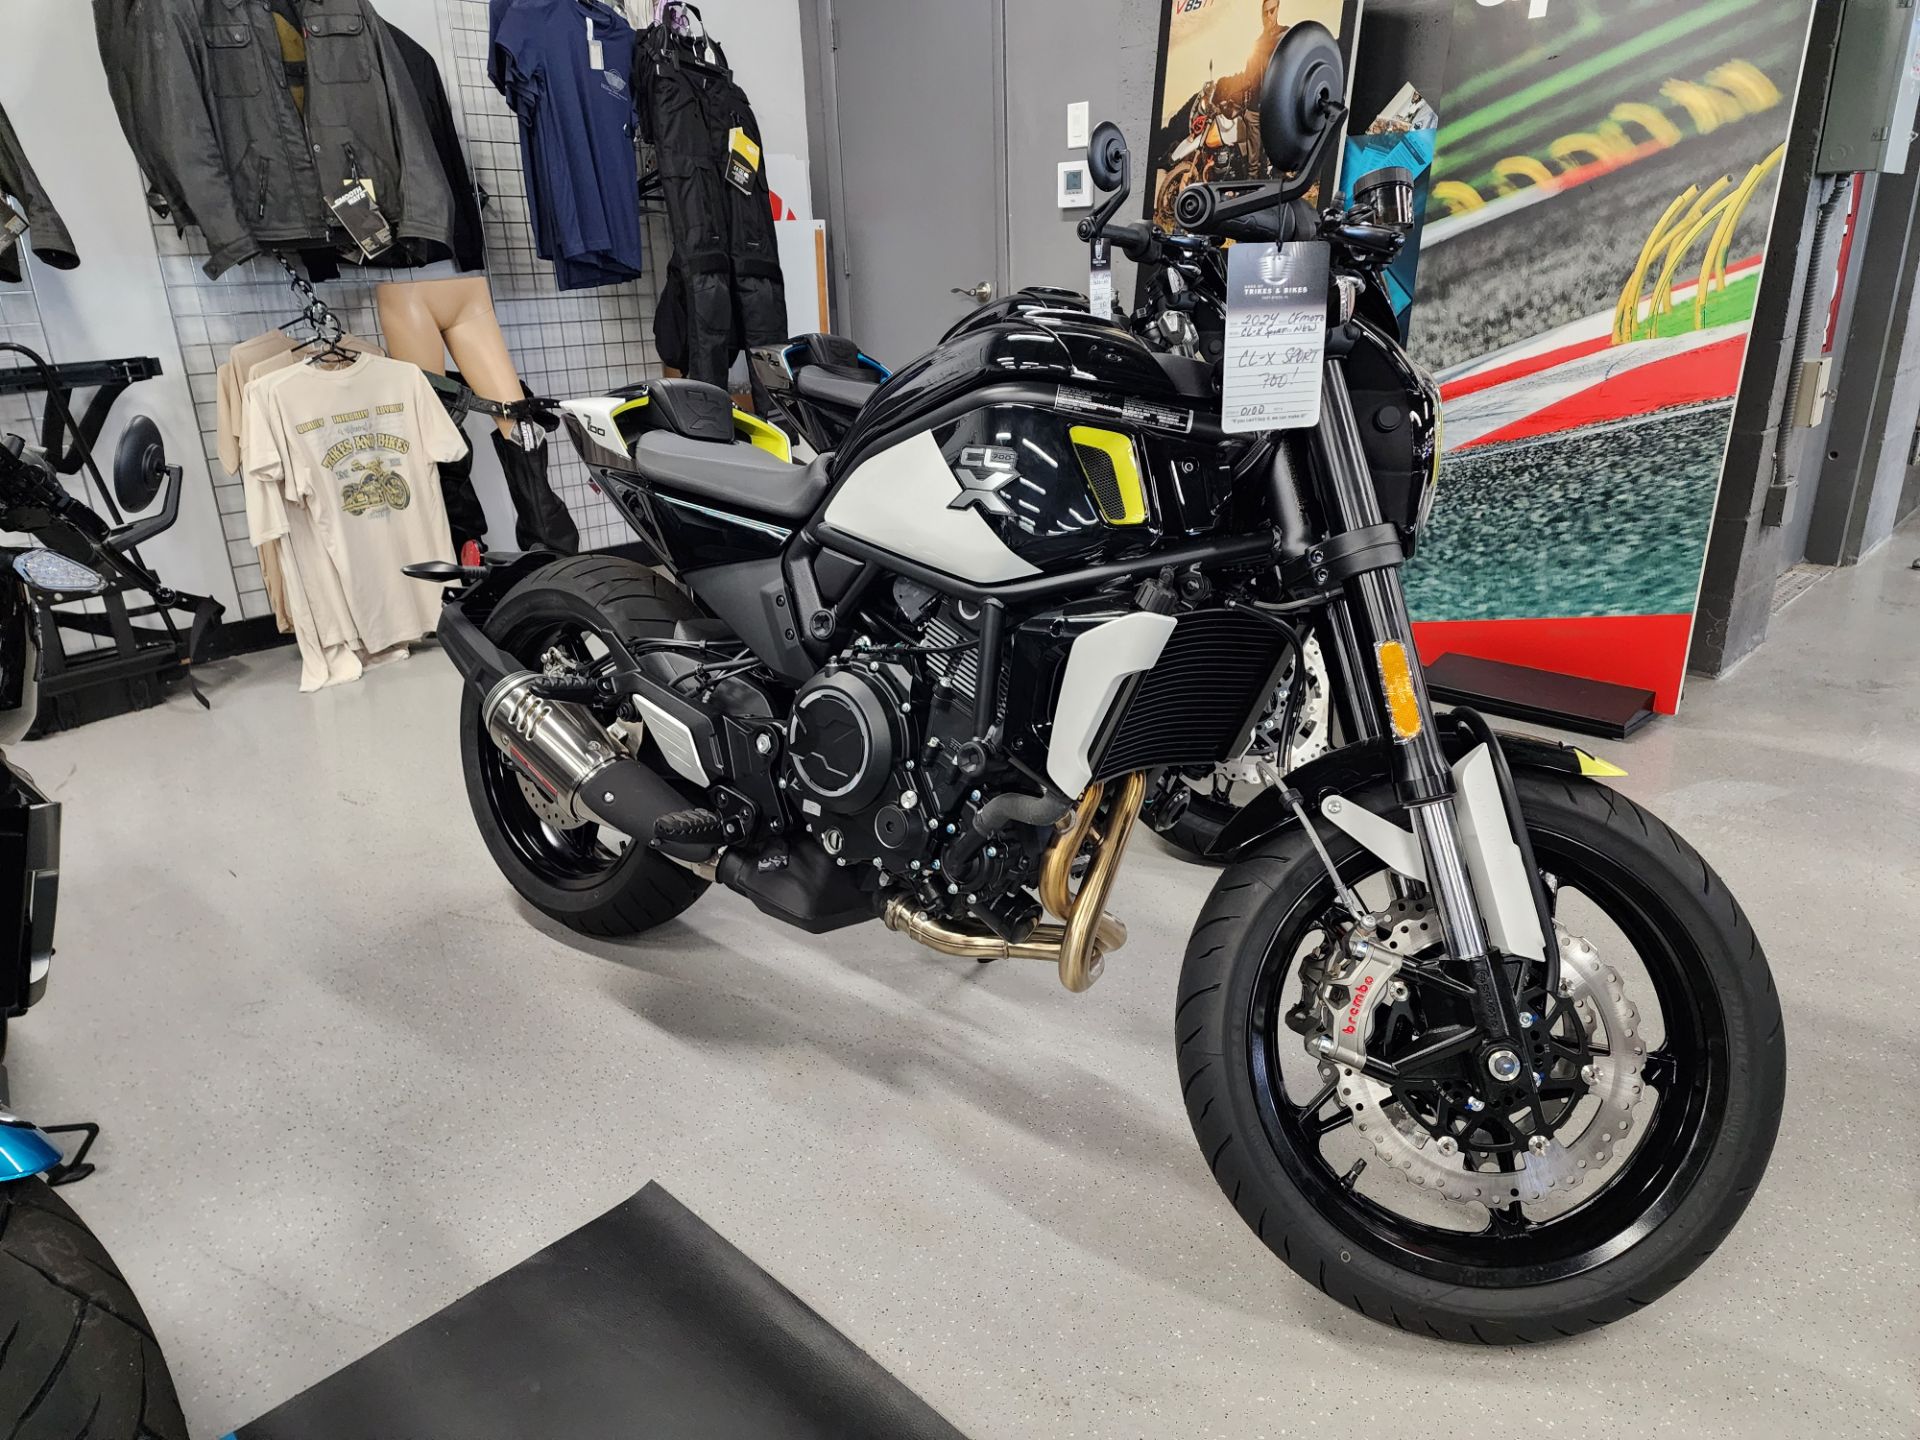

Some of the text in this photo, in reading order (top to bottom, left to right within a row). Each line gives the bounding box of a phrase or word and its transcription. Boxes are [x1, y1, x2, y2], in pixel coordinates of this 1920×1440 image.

[1244, 288, 1272, 296] TRIKES
[1284, 286, 1309, 294] BIKES
[1241, 312, 1280, 326] 2024
[1238, 349, 1276, 368] CL-X
[583, 413, 606, 437] 700
[376, 432, 410, 455] BIKES
[1342, 975, 1375, 1035] brembo
